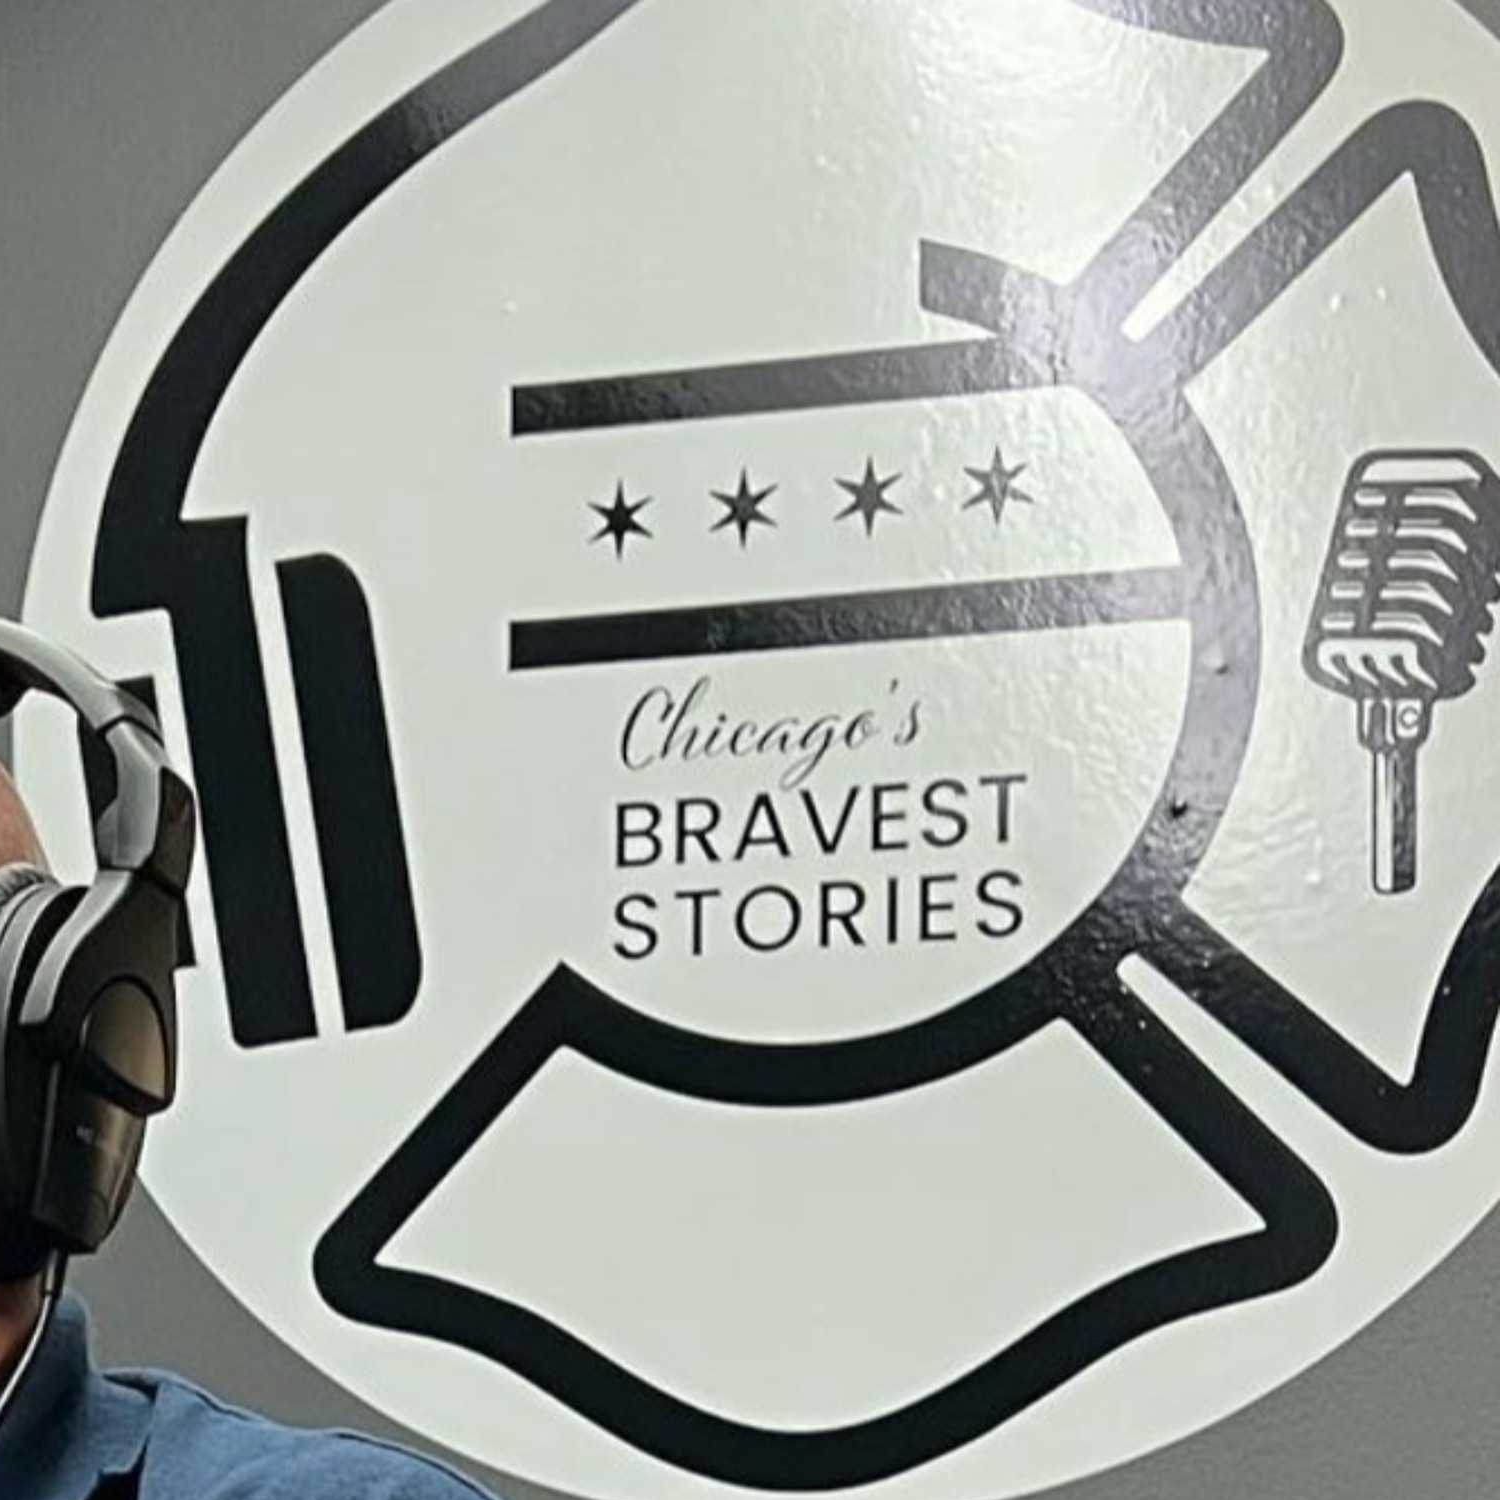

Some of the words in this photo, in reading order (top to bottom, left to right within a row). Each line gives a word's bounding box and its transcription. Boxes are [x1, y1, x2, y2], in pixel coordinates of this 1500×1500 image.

[619, 675, 920, 791] Chicago's
[615, 774, 1028, 868] BRAVEST
[613, 870, 1023, 960] STORIES
